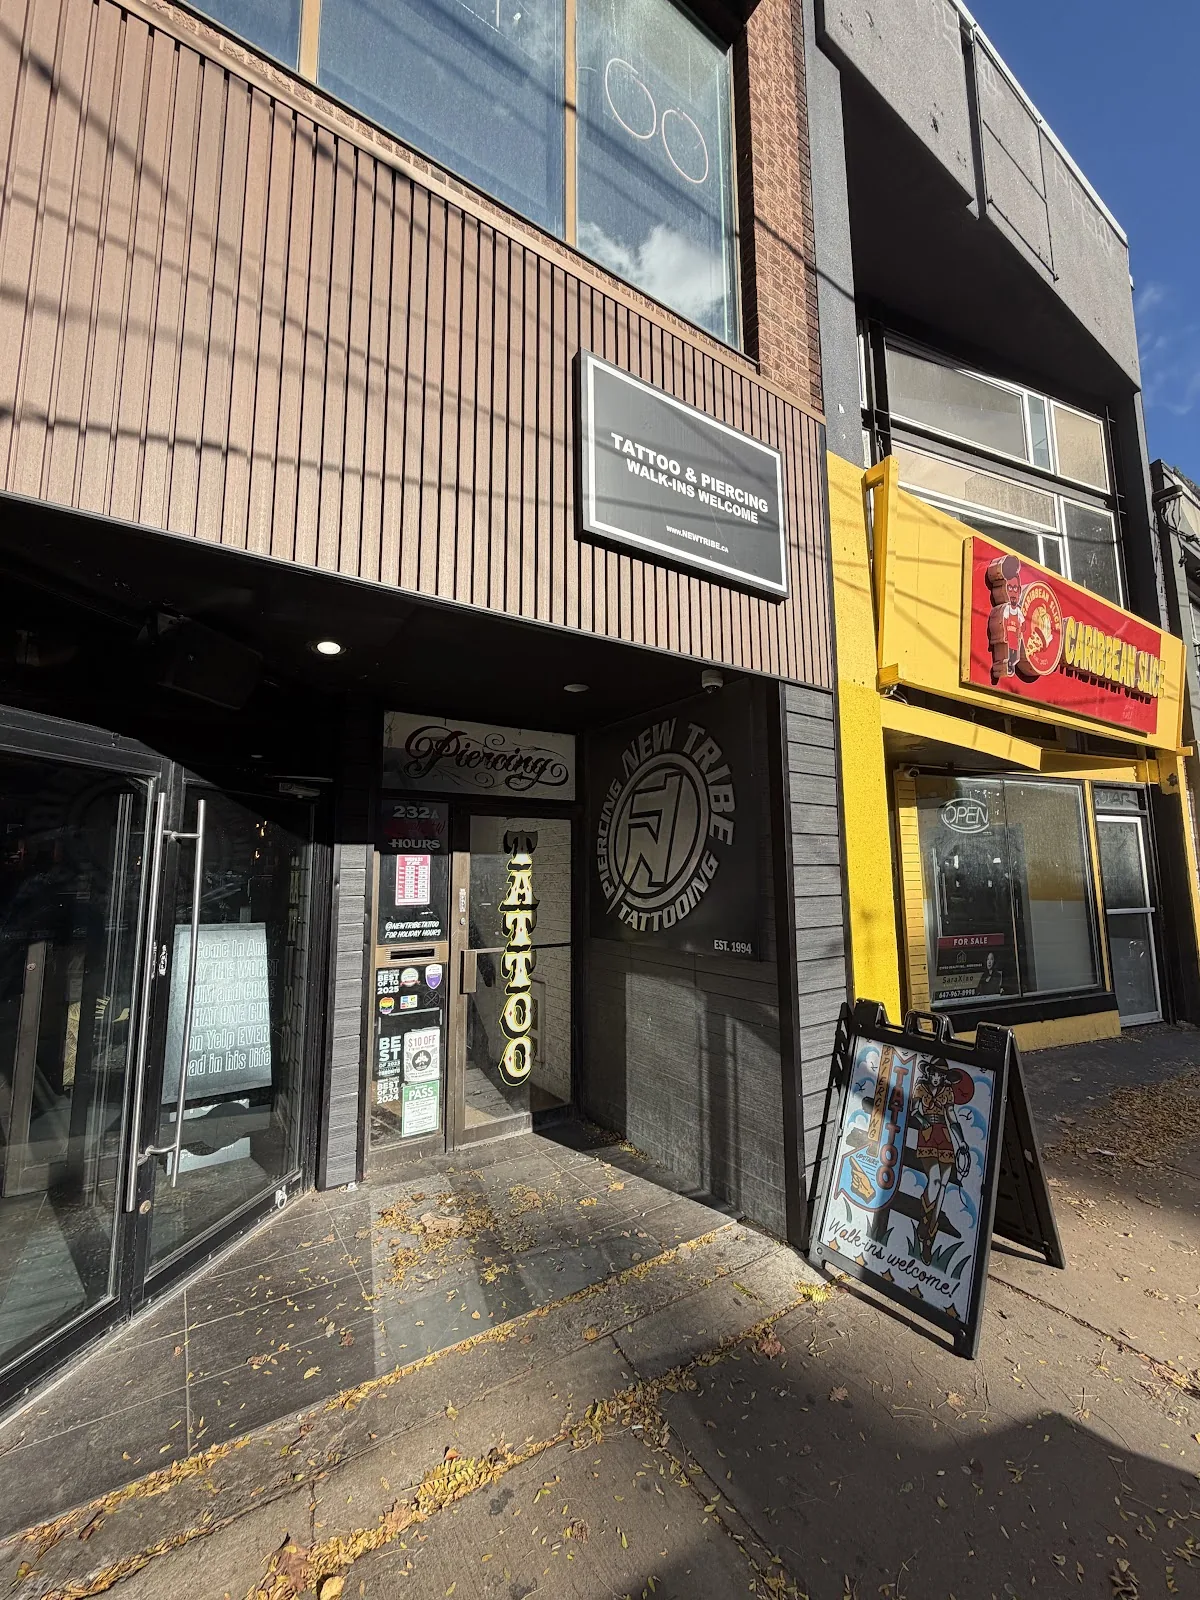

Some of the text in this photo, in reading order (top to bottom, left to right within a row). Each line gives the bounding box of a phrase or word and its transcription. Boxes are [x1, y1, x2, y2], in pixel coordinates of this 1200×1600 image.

[611, 432, 769, 513] TATTOO & PIERCING
[626, 458, 759, 524] WALK-INS WELCOME
[1022, 588, 1050, 617] CARIBBEAN
[1065, 616, 1166, 698] CARIBBEAN SLICE
[404, 725, 568, 791] Piercing
[621, 718, 736, 845] NEW TRIBE
[392, 806, 439, 819] 232A
[944, 806, 988, 824] OPEN
[388, 838, 440, 850] HOURS
[597, 778, 624, 899] PIERCING
[617, 850, 719, 932] TATTOOING
[385, 929, 441, 939] FOR HOLIDAY HOURS
[953, 937, 988, 946] FOR SALE
[232, 940, 245, 957] In
[247, 938, 270, 957] And
[499, 829, 540, 1086] TATTOO
[714, 940, 752, 954] EST. 1994
[211, 962, 235, 980] THE
[237, 959, 279, 979] WORST
[377, 973, 400, 982] BEST
[218, 982, 241, 1002] and
[244, 980, 275, 1000] COKE
[376, 985, 400, 995] 2025
[193, 1006, 218, 1028] HAT
[220, 1004, 245, 1024] ONE
[207, 1029, 235, 1050] Yelp
[238, 1023, 269, 1046] EVER
[379, 1035, 402, 1050] BE
[408, 1036, 422, 1048] $10
[423, 1034, 437, 1045] OFF
[187, 1054, 206, 1077] ad
[208, 1053, 222, 1074] in
[225, 1050, 247, 1071] his
[379, 1048, 401, 1062] ST
[377, 1081, 400, 1091] BEST
[408, 1086, 434, 1101] PASS
[376, 1093, 400, 1105] 2024
[868, 1057, 891, 1138] PIERCING
[876, 1065, 909, 1190] TATTOO
[855, 1153, 880, 1166] UPSTAIRS
[828, 1217, 961, 1299] Walk-ins welcome!
